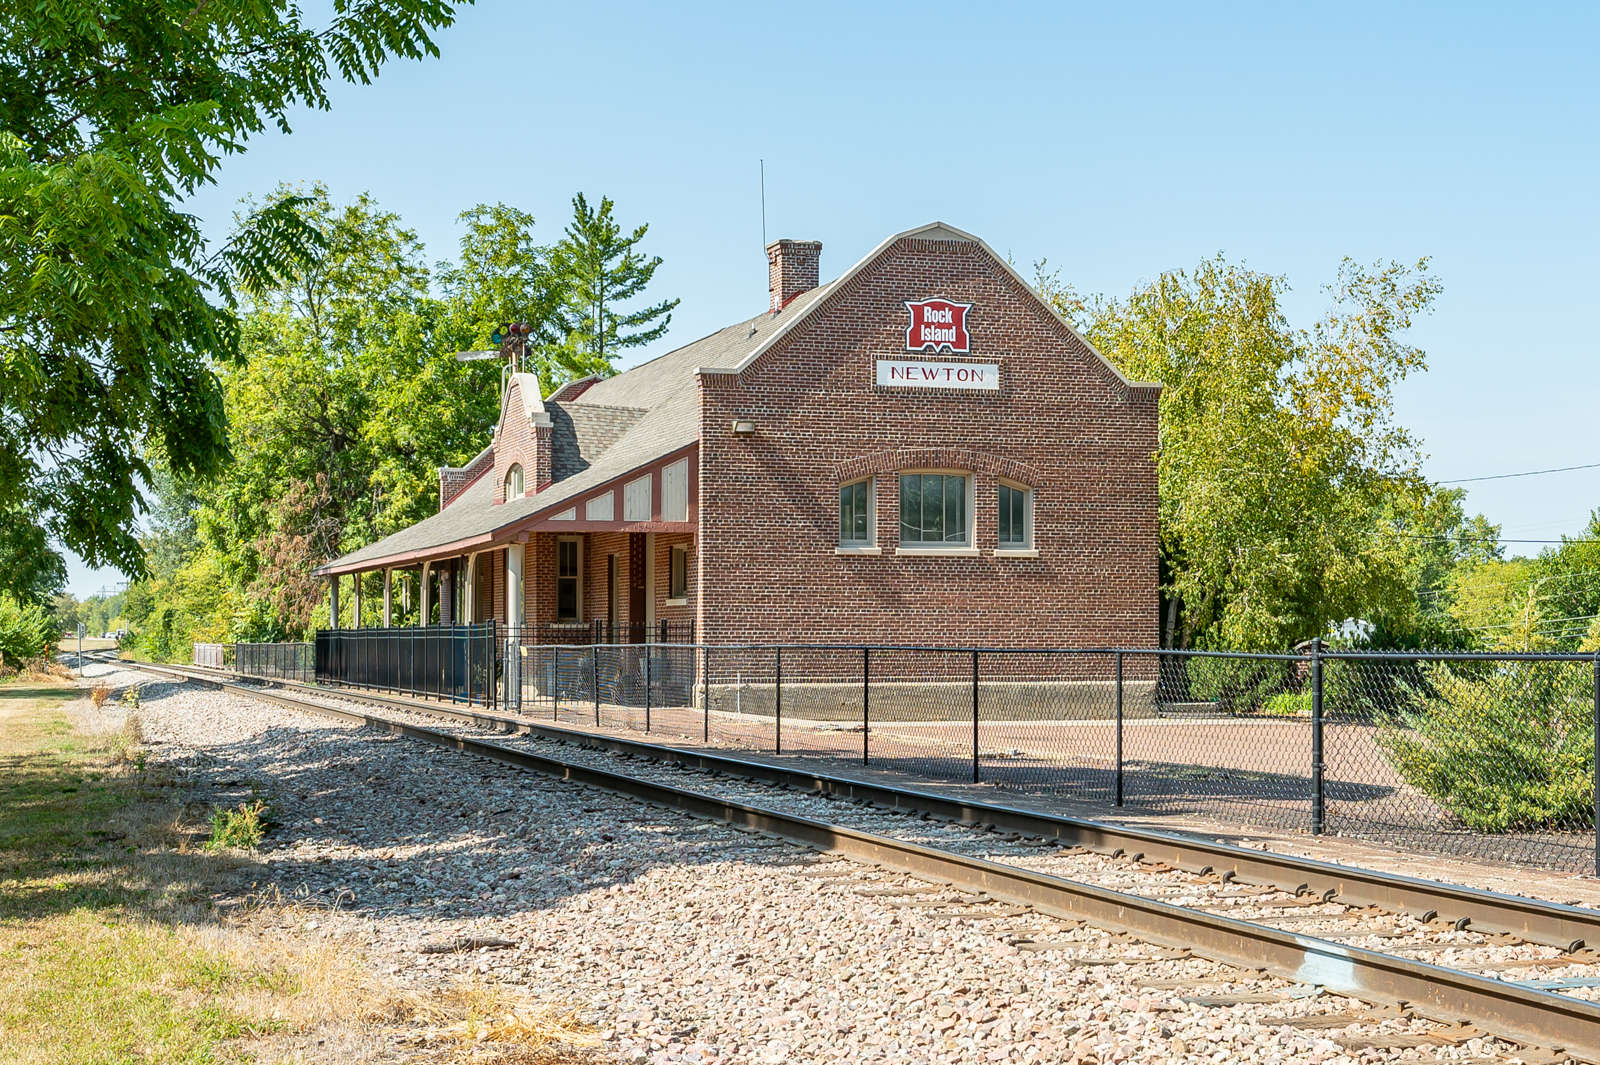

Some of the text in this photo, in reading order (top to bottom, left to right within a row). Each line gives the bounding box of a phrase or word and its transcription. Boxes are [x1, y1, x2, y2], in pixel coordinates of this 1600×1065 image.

[923, 306, 953, 324] Rock
[920, 324, 957, 342] Island
[891, 366, 984, 382] NEWTON
